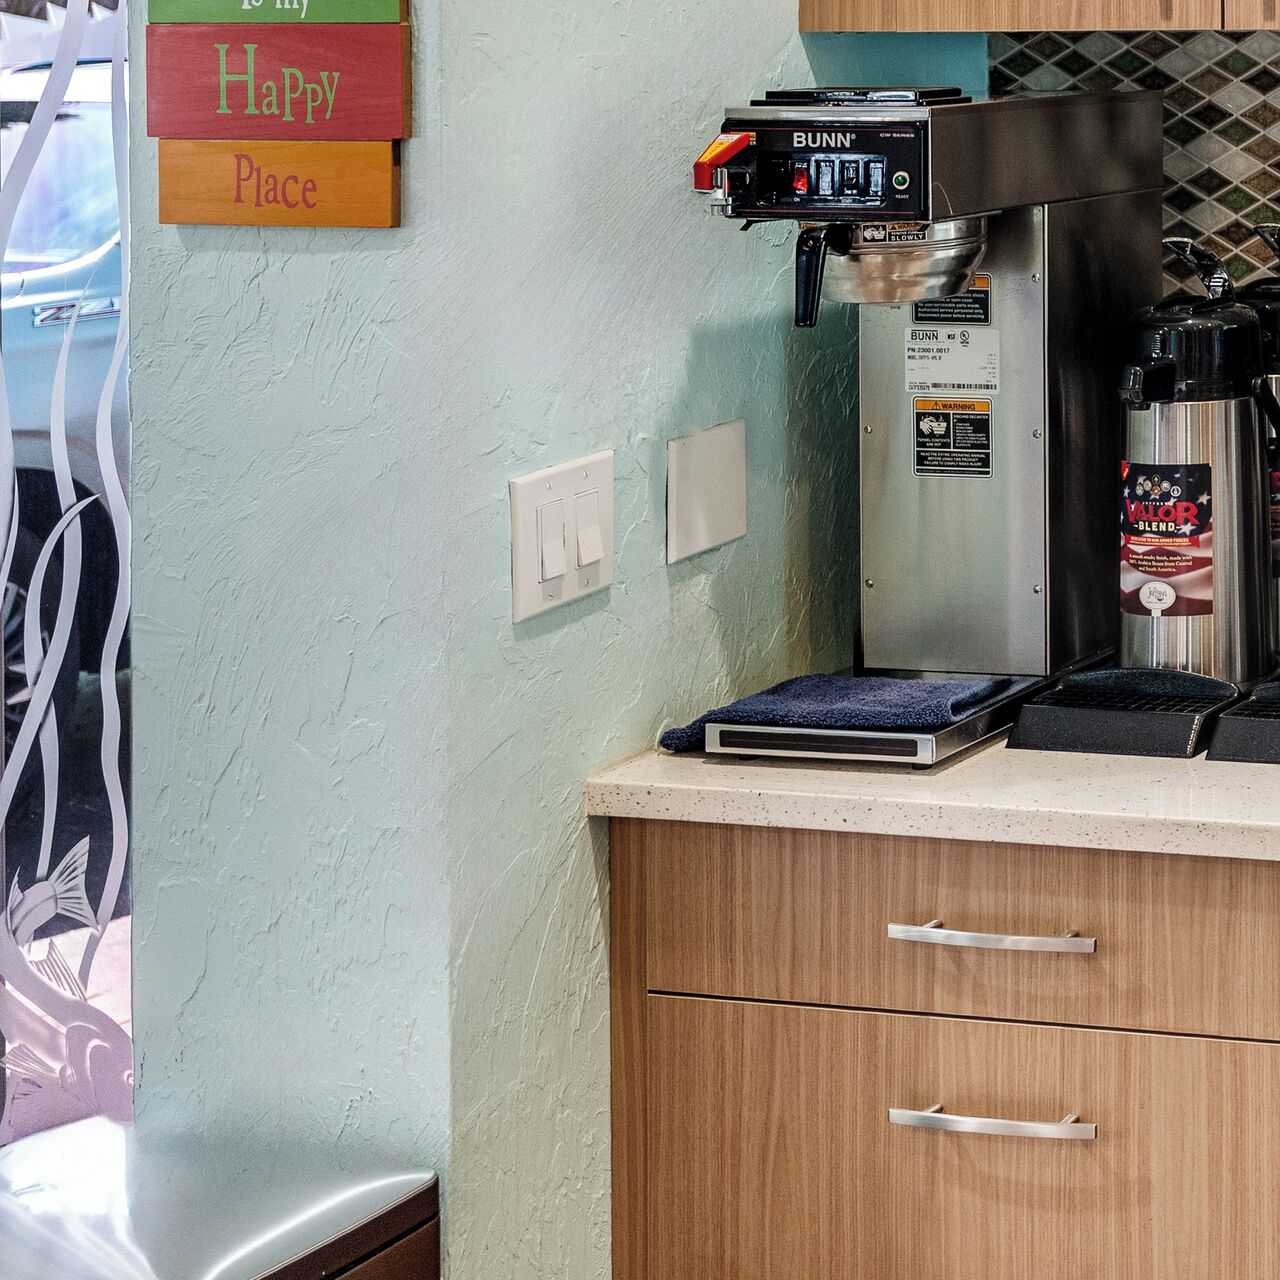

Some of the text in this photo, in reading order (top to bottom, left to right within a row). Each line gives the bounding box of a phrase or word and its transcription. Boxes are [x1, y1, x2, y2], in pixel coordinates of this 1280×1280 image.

[214, 43, 341, 124] Happy
[233, 153, 318, 209] Place
[890, 233, 924, 241] SLOWLY
[911, 331, 938, 341] BUNN
[941, 403, 975, 411] WARNING
[1126, 499, 1200, 525] VALOR
